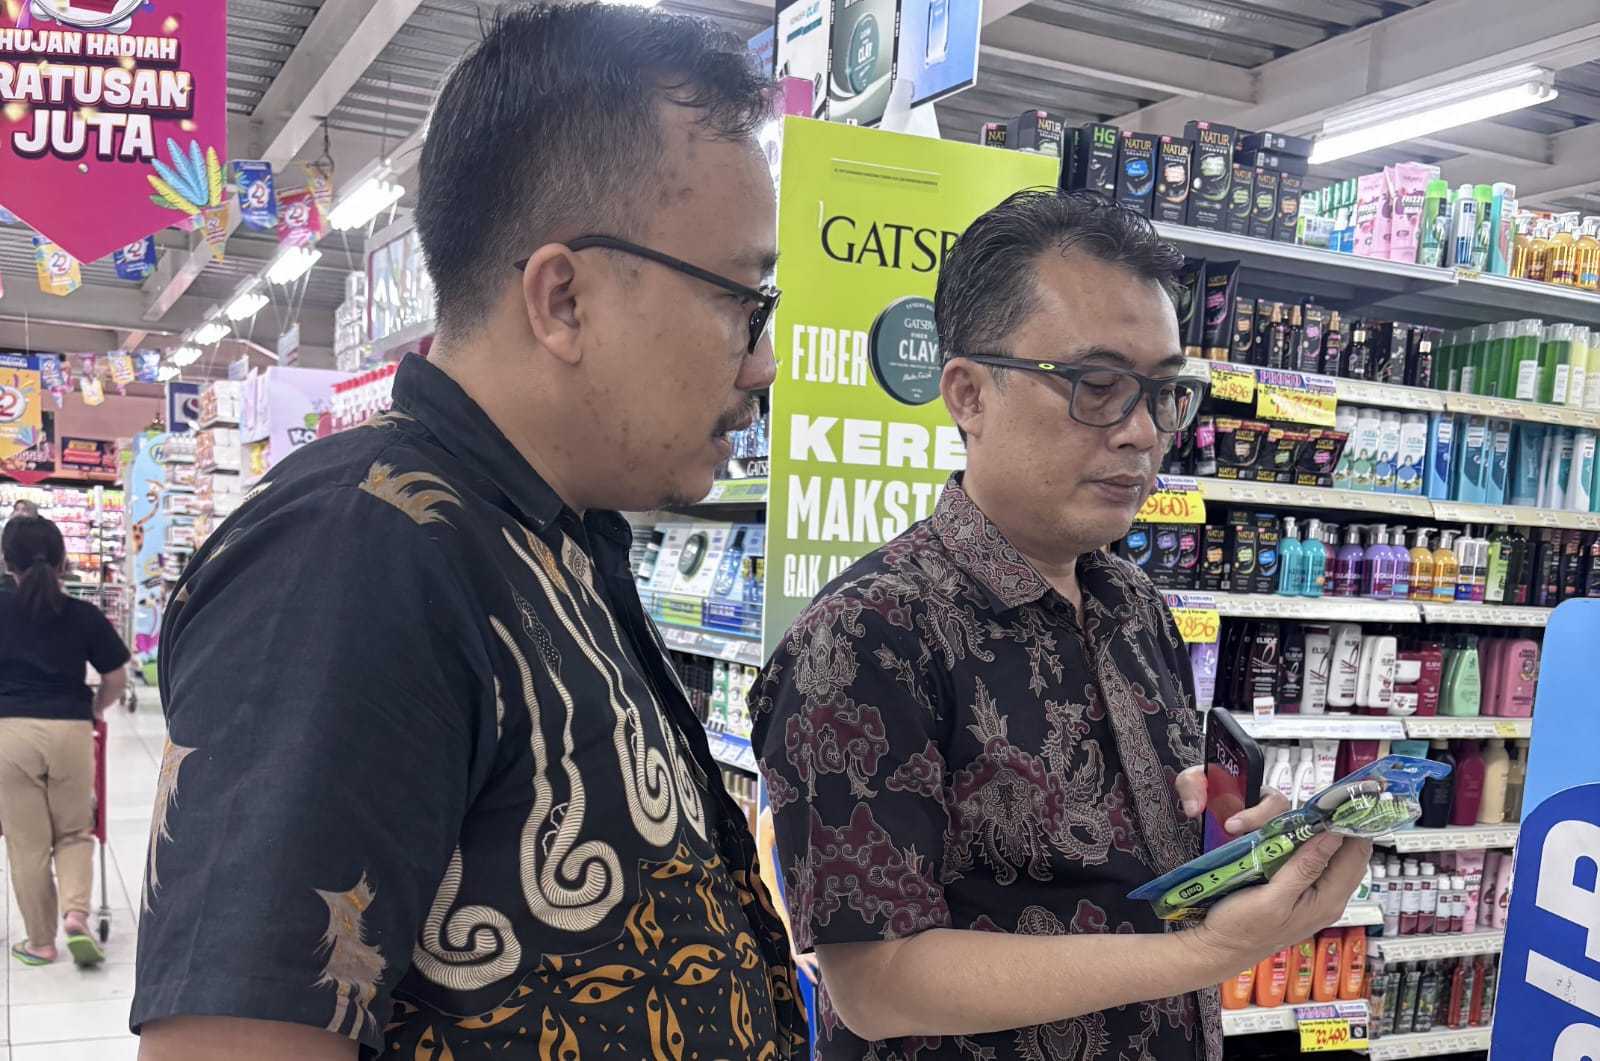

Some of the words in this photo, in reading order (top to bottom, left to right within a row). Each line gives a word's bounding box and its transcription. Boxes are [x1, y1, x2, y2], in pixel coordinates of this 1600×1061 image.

[0, 28, 82, 55] HUJAN
[85, 33, 178, 60] HADIAH
[13, 109, 155, 157] JUTA
[1093, 127, 1116, 144] HG
[1200, 130, 1230, 146] NATUR
[792, 324, 868, 387] FIBER
[898, 339, 939, 363] CLAY
[790, 414, 968, 470] KERE
[783, 554, 822, 597] GAK
